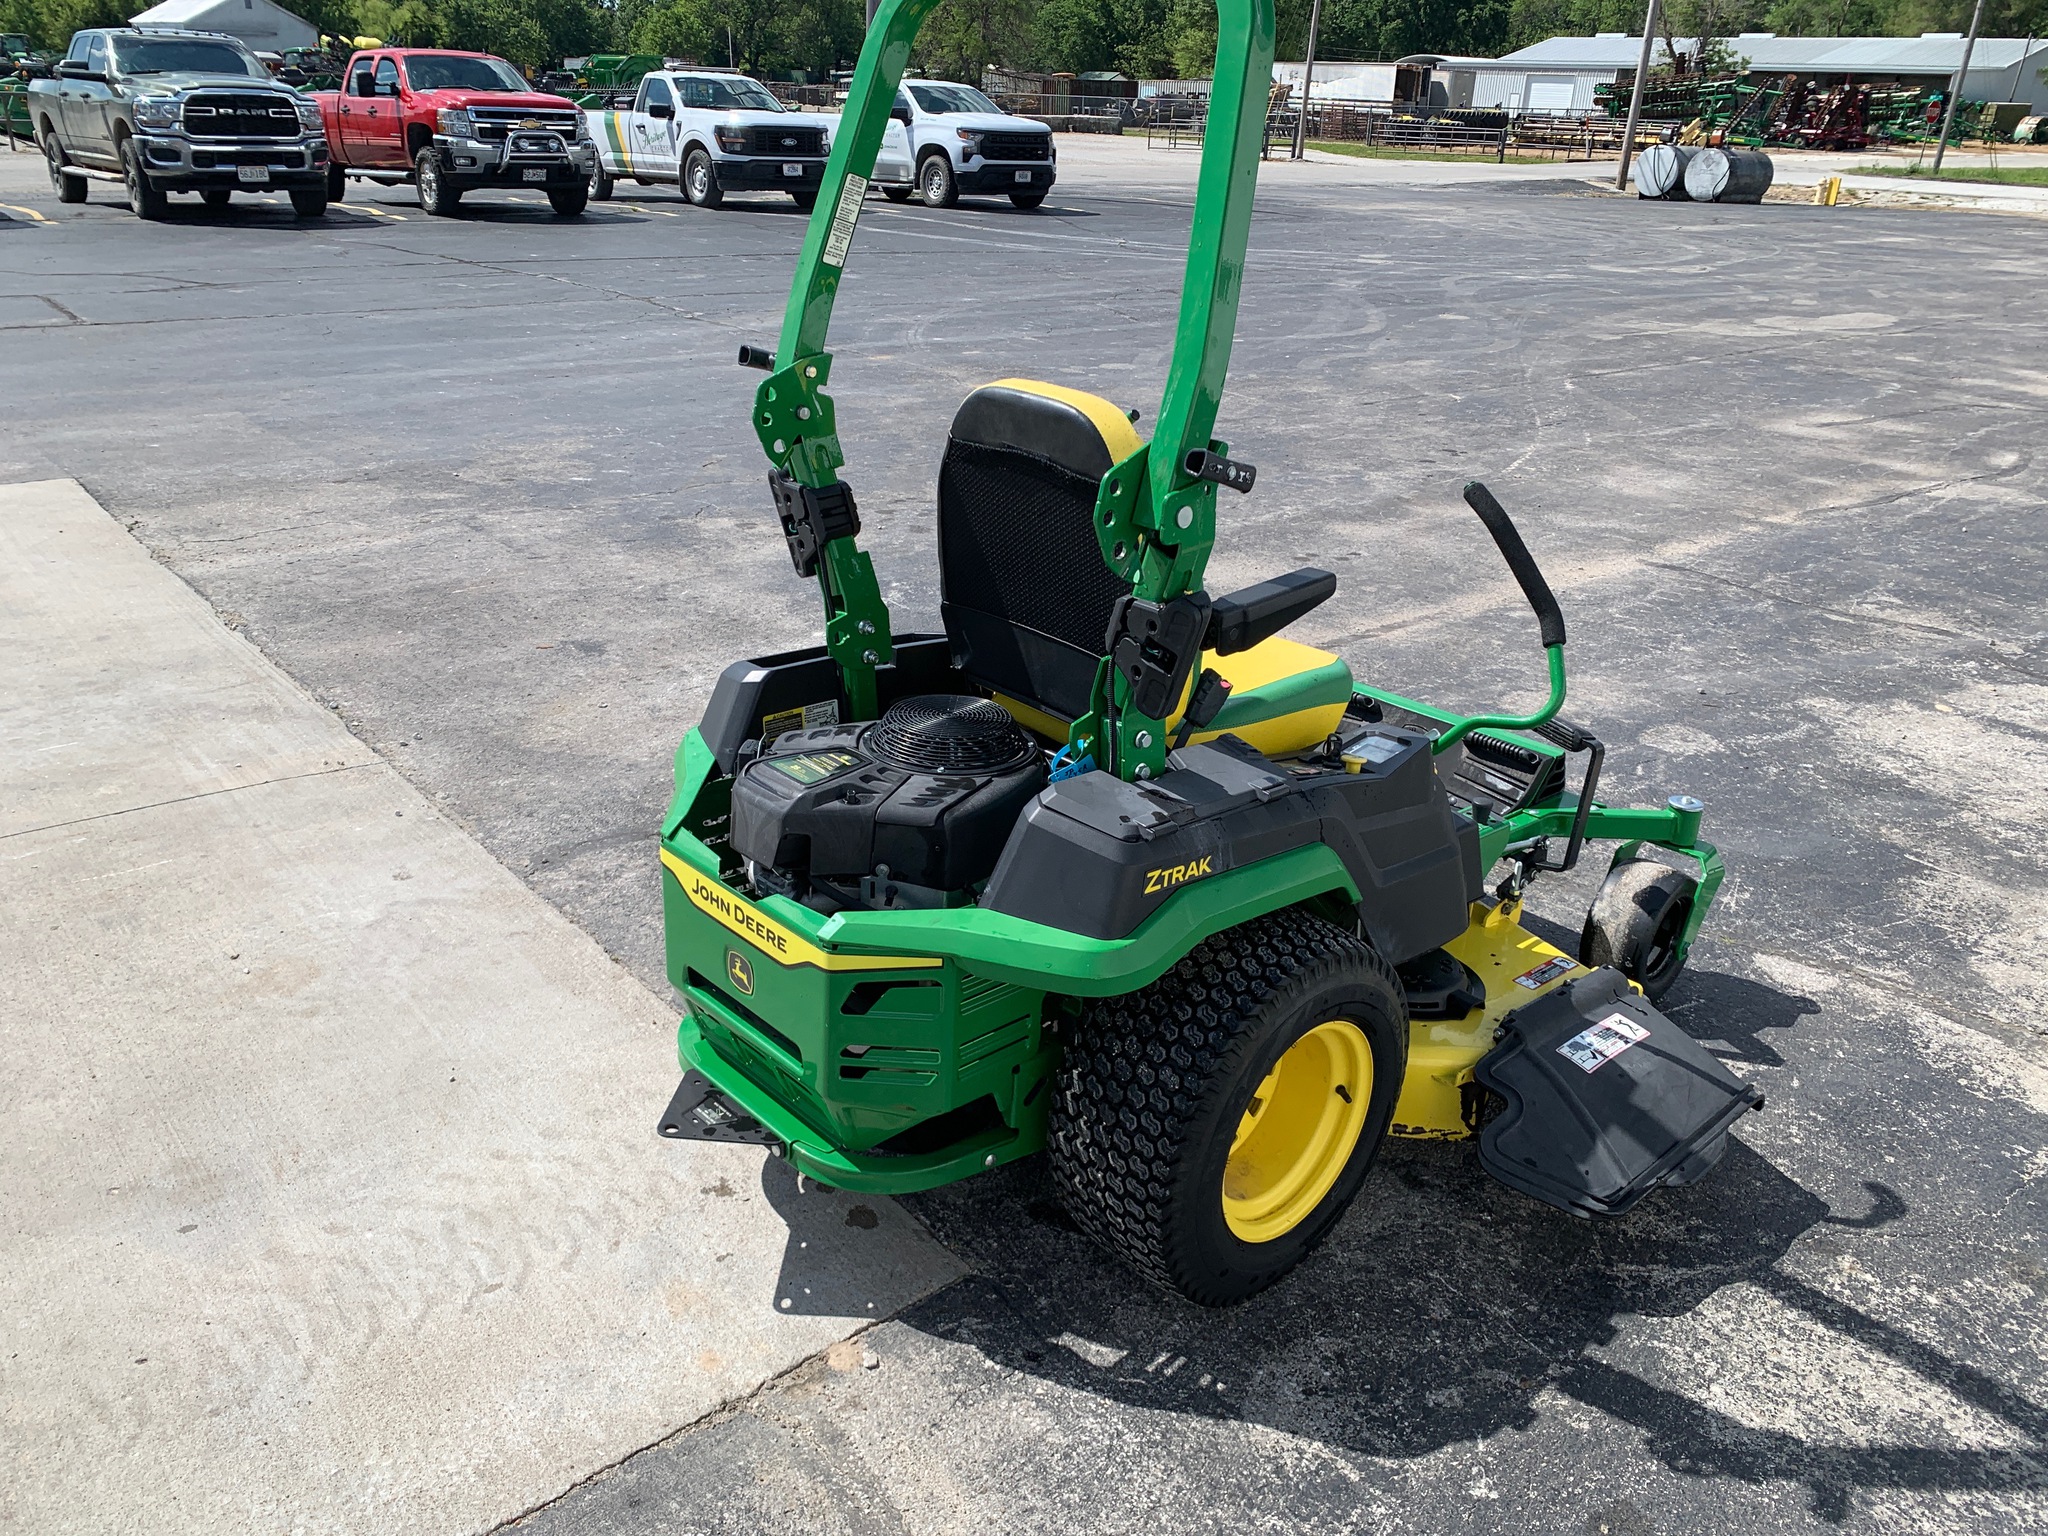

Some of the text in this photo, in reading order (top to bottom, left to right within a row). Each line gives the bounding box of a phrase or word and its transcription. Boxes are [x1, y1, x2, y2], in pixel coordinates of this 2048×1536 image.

[218, 108, 267, 116] RAM
[1143, 855, 1212, 895] ZTRAK
[691, 878, 788, 954] JOHN DEERE
